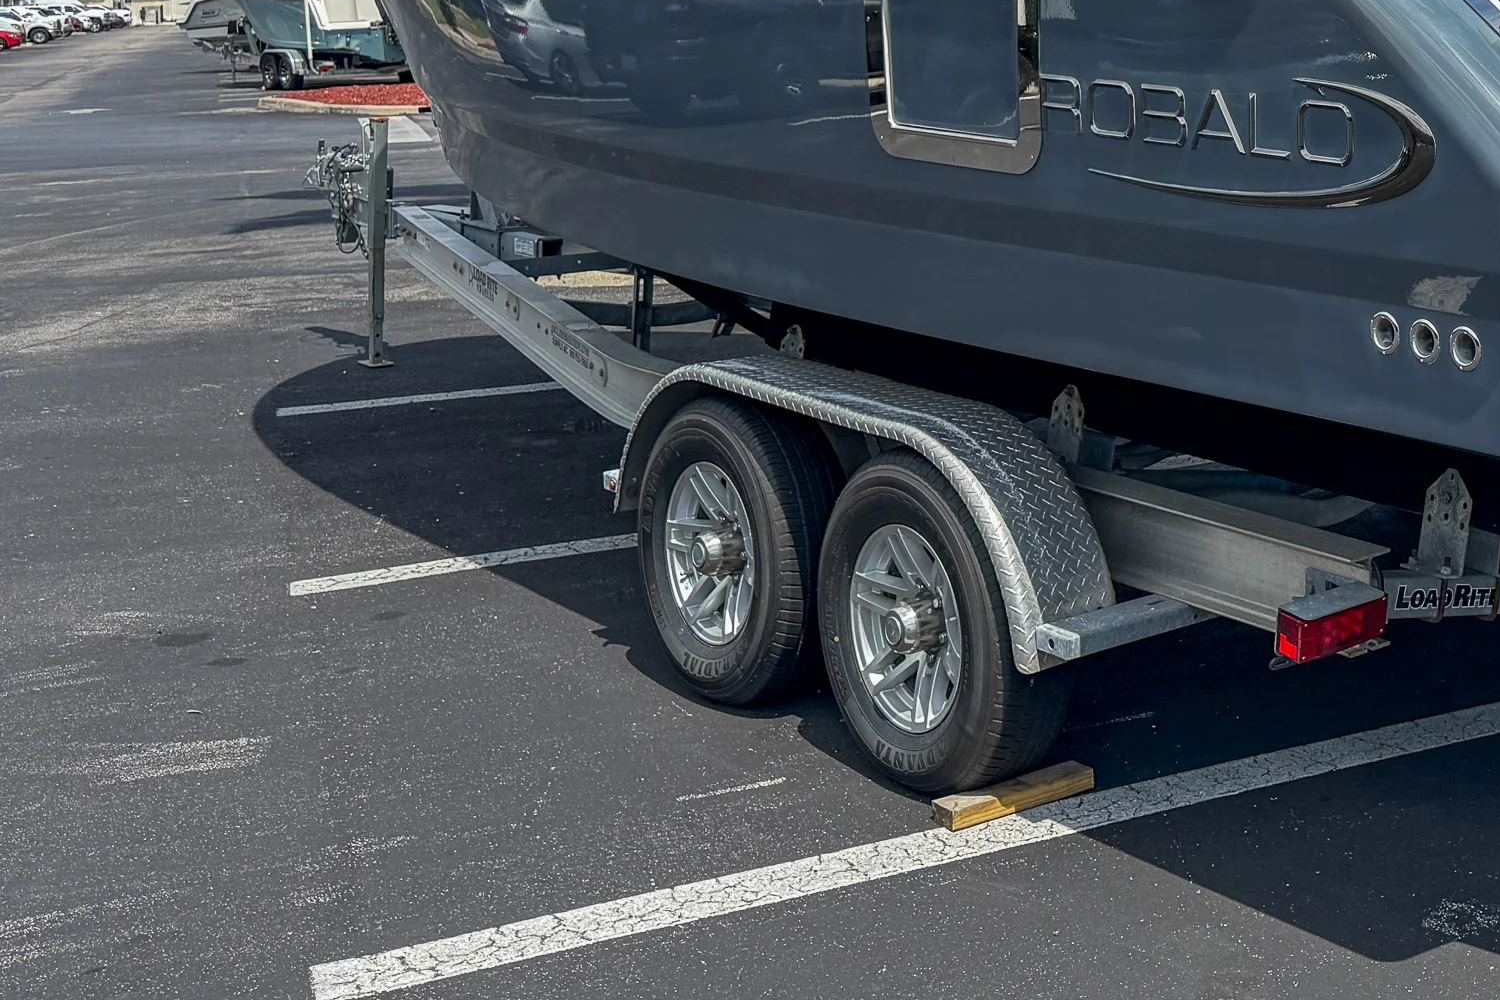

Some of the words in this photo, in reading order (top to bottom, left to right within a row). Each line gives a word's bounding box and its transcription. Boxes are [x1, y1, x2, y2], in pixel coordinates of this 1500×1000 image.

[1040, 74, 1354, 167] ROBALO
[682, 651, 731, 678] RADIAL
[875, 740, 947, 772] ADVANTA
